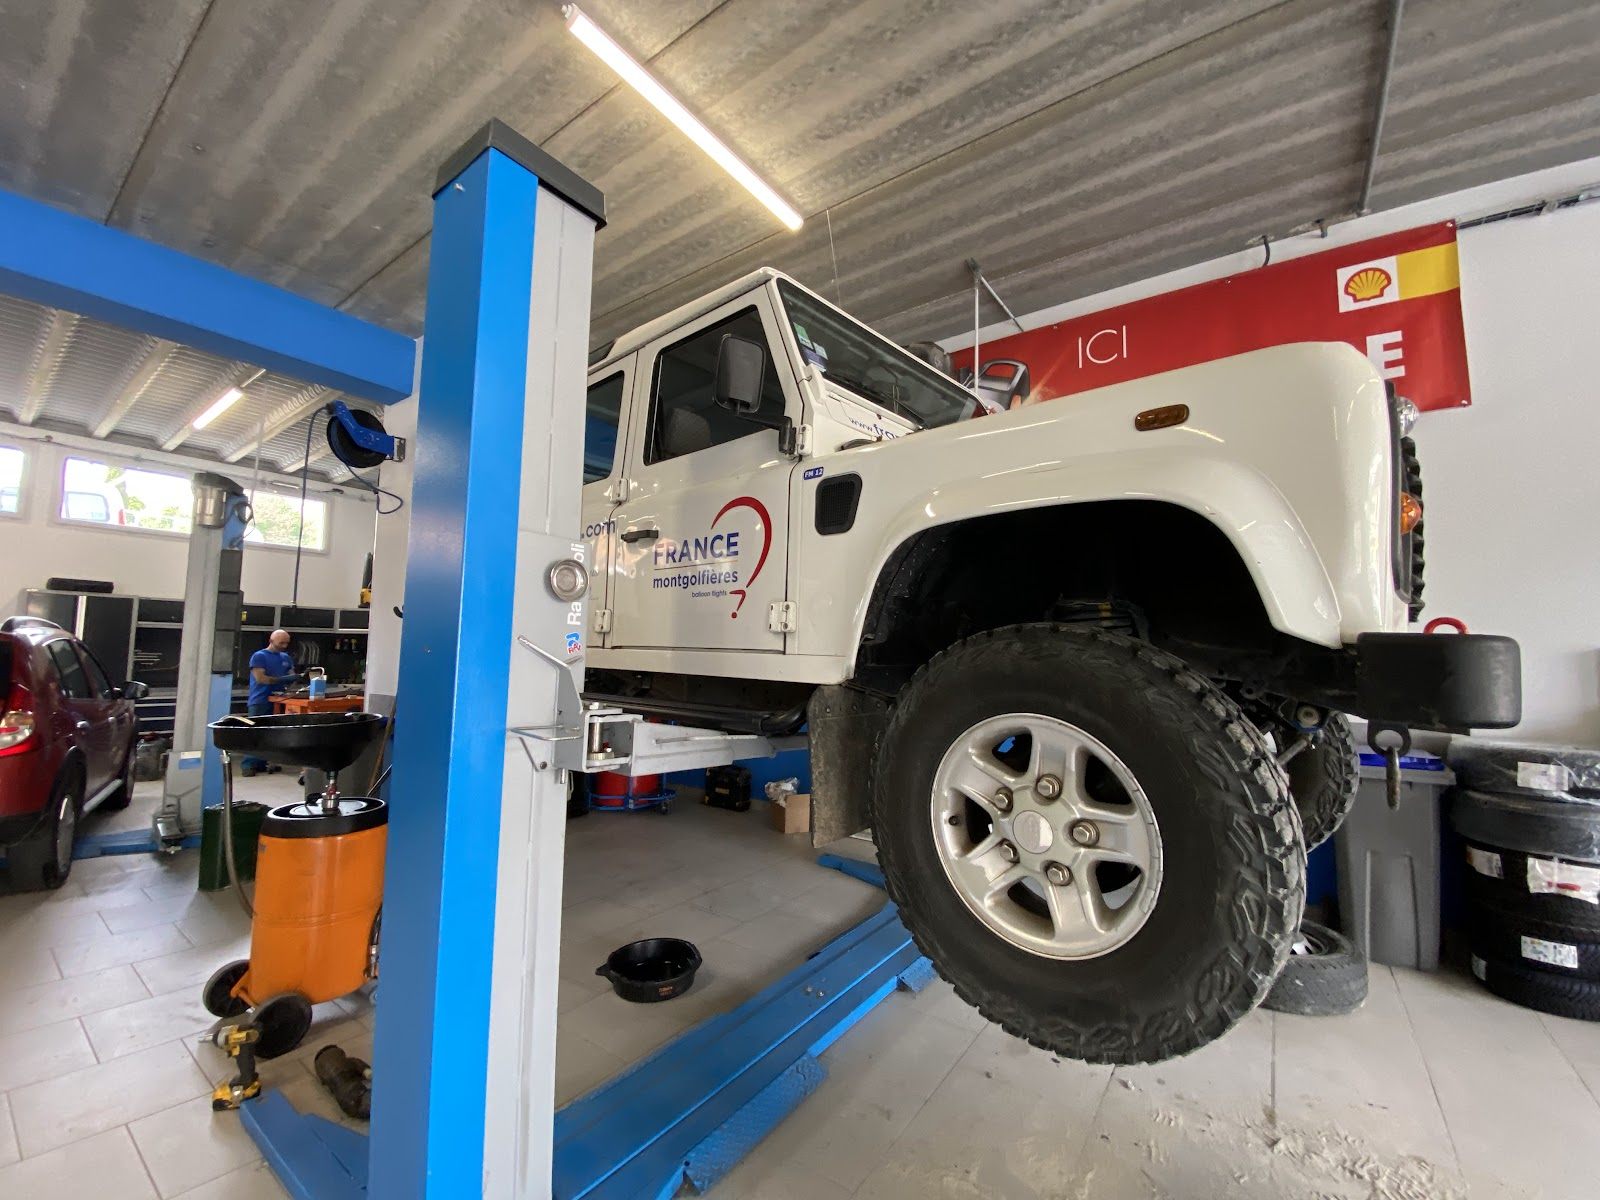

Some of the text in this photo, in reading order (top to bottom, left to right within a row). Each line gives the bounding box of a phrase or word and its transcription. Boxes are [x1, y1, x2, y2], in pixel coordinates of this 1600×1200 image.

[1077, 324, 1128, 369] ICI
[815, 468, 823, 476] 12
[653, 531, 740, 566] FRANCE
[652, 568, 739, 589] montgolfières
[691, 589, 727, 598] balloon flights
